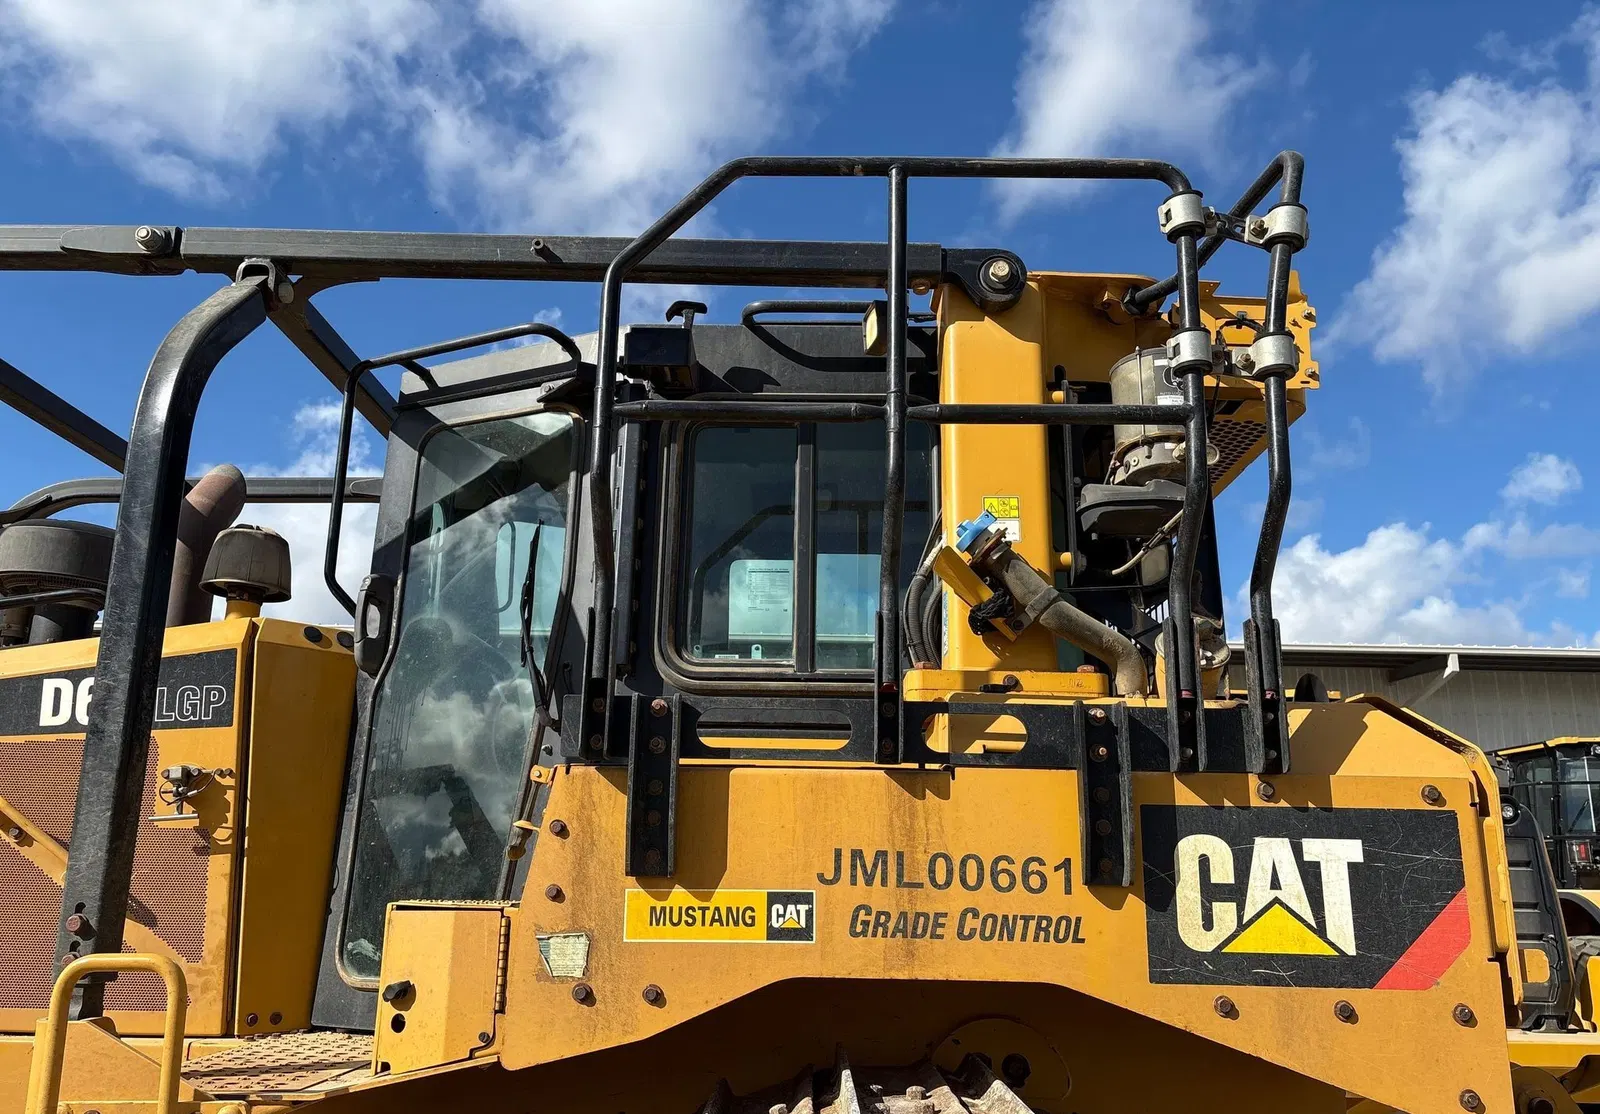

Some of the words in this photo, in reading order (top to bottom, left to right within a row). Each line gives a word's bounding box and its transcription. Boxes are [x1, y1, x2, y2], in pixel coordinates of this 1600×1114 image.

[154, 685, 227, 722] LGP
[816, 847, 1073, 896] JML00661
[1174, 834, 1364, 956] CAT
[649, 905, 756, 928] MUSTANG
[771, 903, 809, 928] CAT
[849, 904, 949, 940] GRADE
[956, 907, 1087, 944] CONTROL
